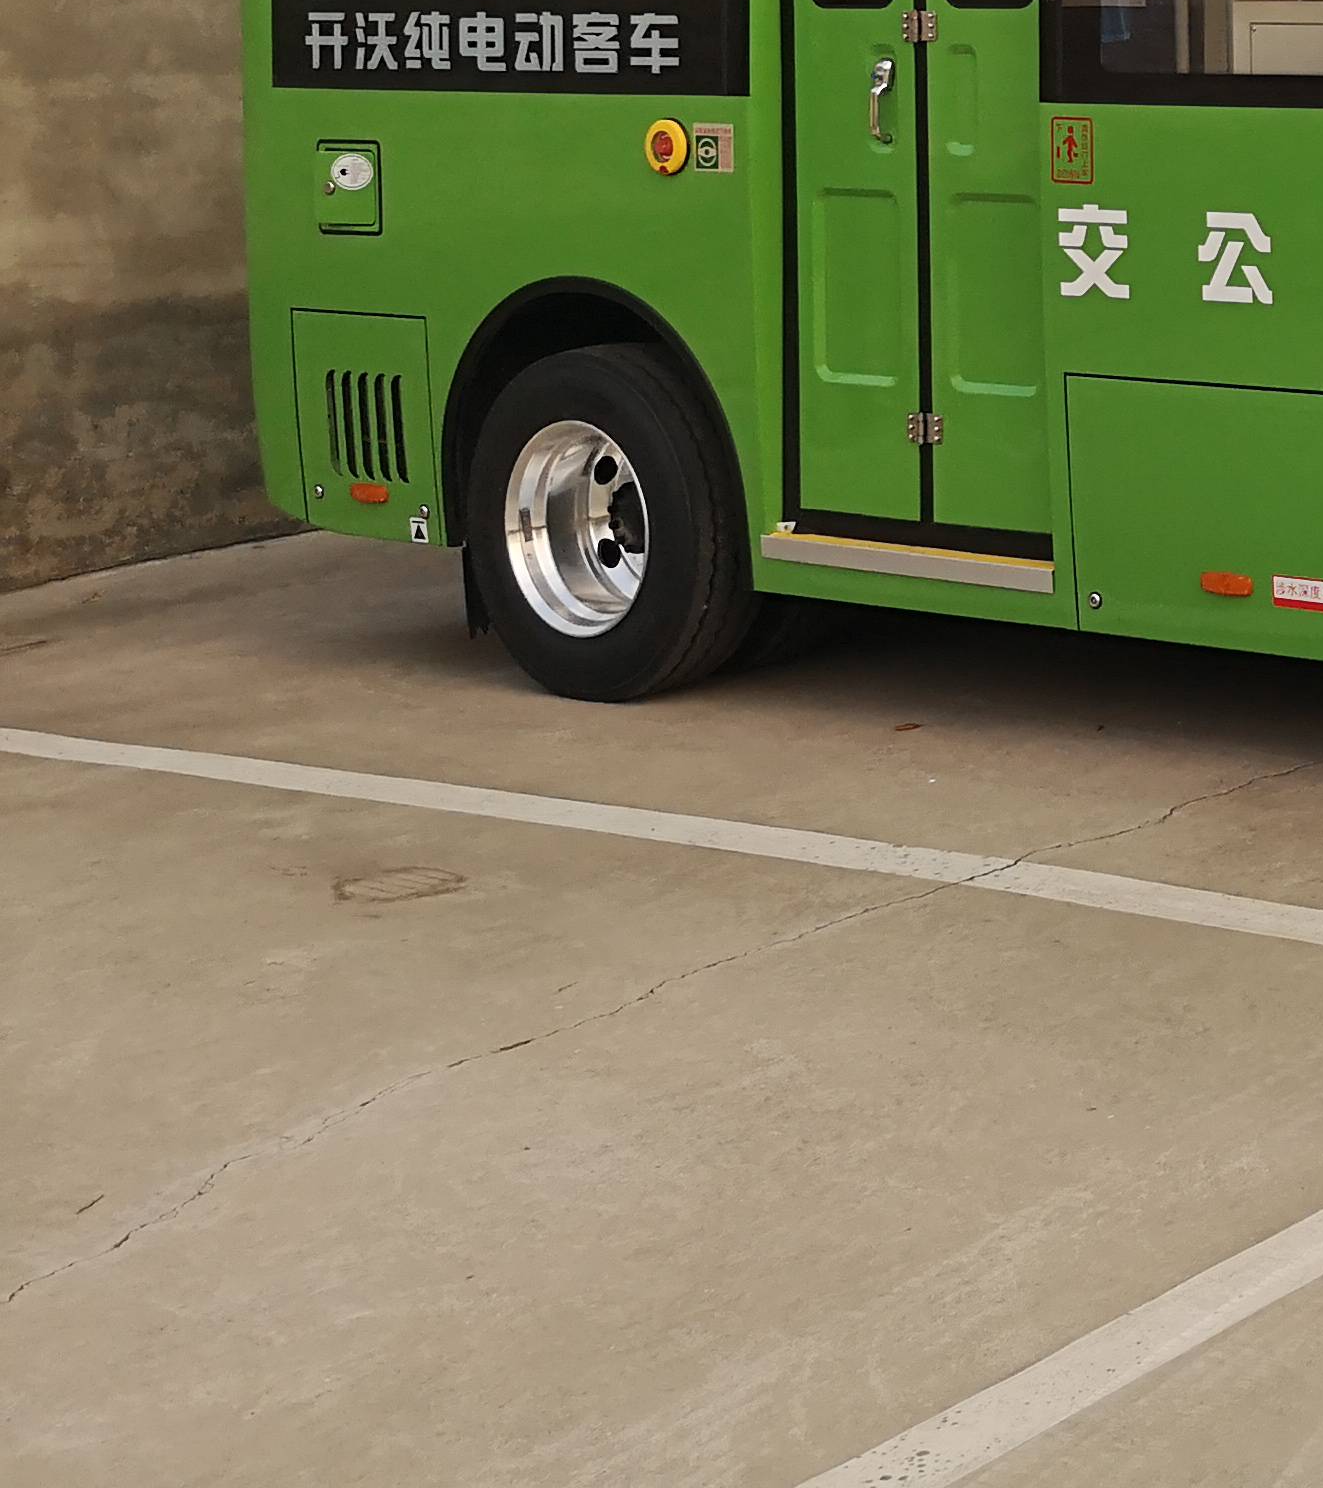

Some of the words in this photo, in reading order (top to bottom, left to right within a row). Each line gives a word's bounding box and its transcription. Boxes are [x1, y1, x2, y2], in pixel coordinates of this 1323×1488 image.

[305, 11, 680, 74] 开沃纯电动客车
